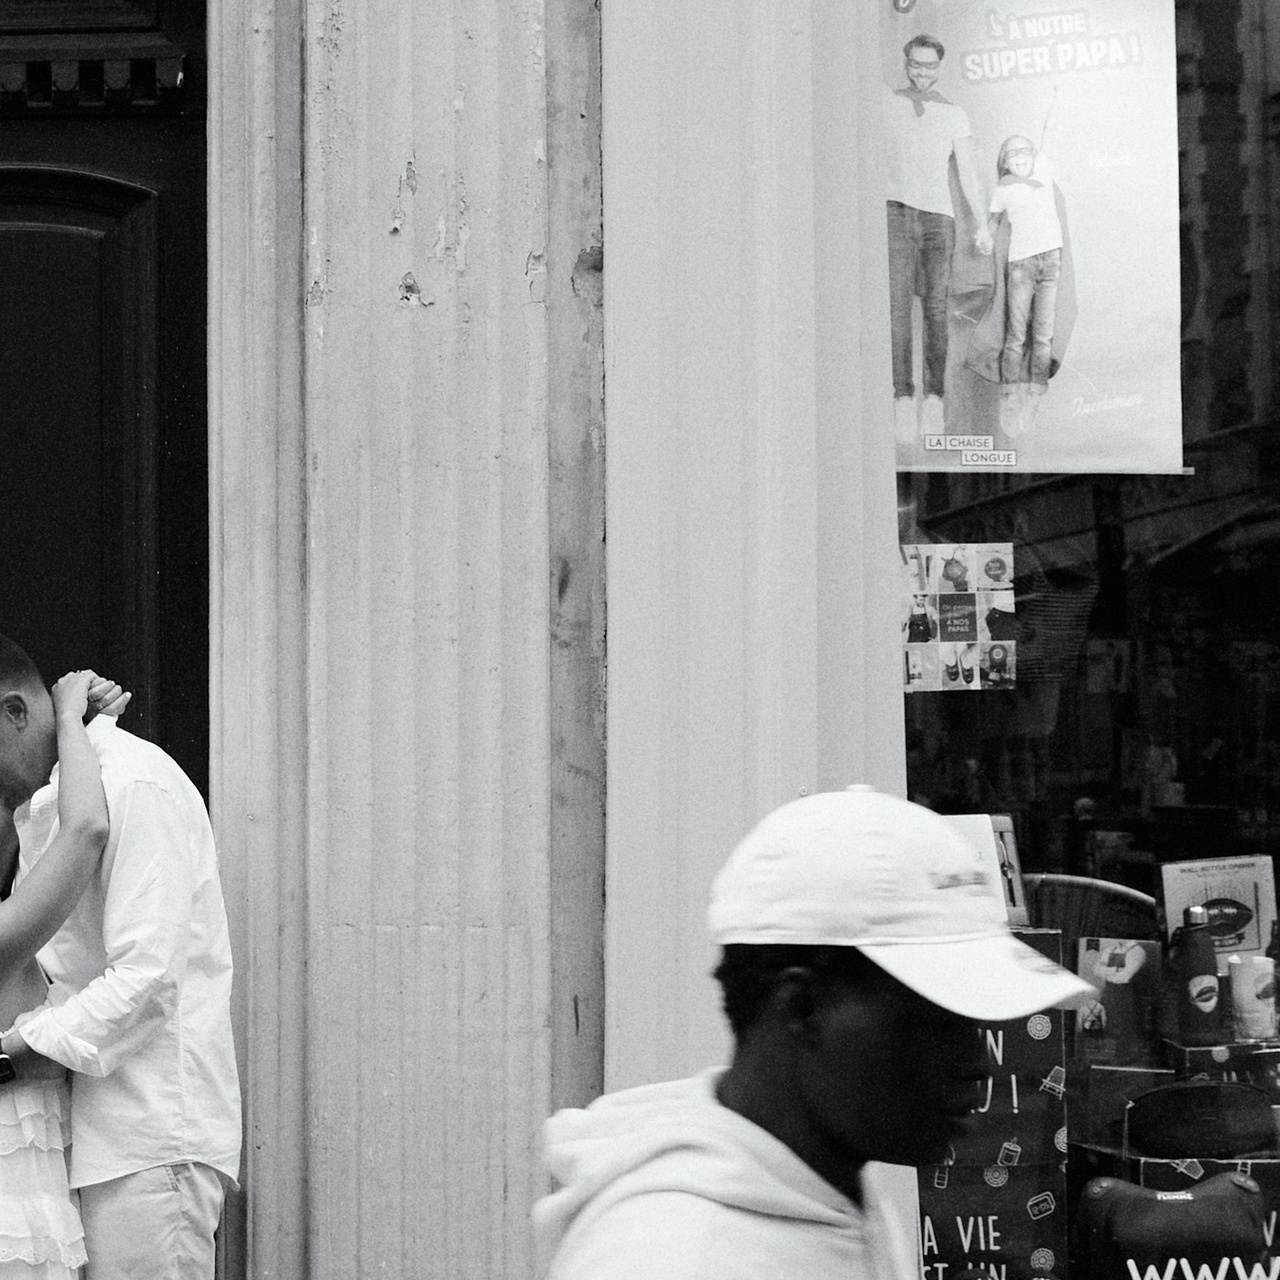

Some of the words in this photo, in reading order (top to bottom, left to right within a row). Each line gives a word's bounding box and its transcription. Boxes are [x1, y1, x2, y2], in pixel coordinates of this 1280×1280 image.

[1024, 12, 1088, 38] NOTRE
[964, 45, 1051, 81] SUPER
[1056, 37, 1127, 70] PAPA
[928, 437, 943, 448] LA
[949, 437, 990, 448] CHAISE
[964, 452, 1014, 463] LONGUE
[923, 1214, 939, 1256] A
[955, 1215, 1001, 1254] VIE
